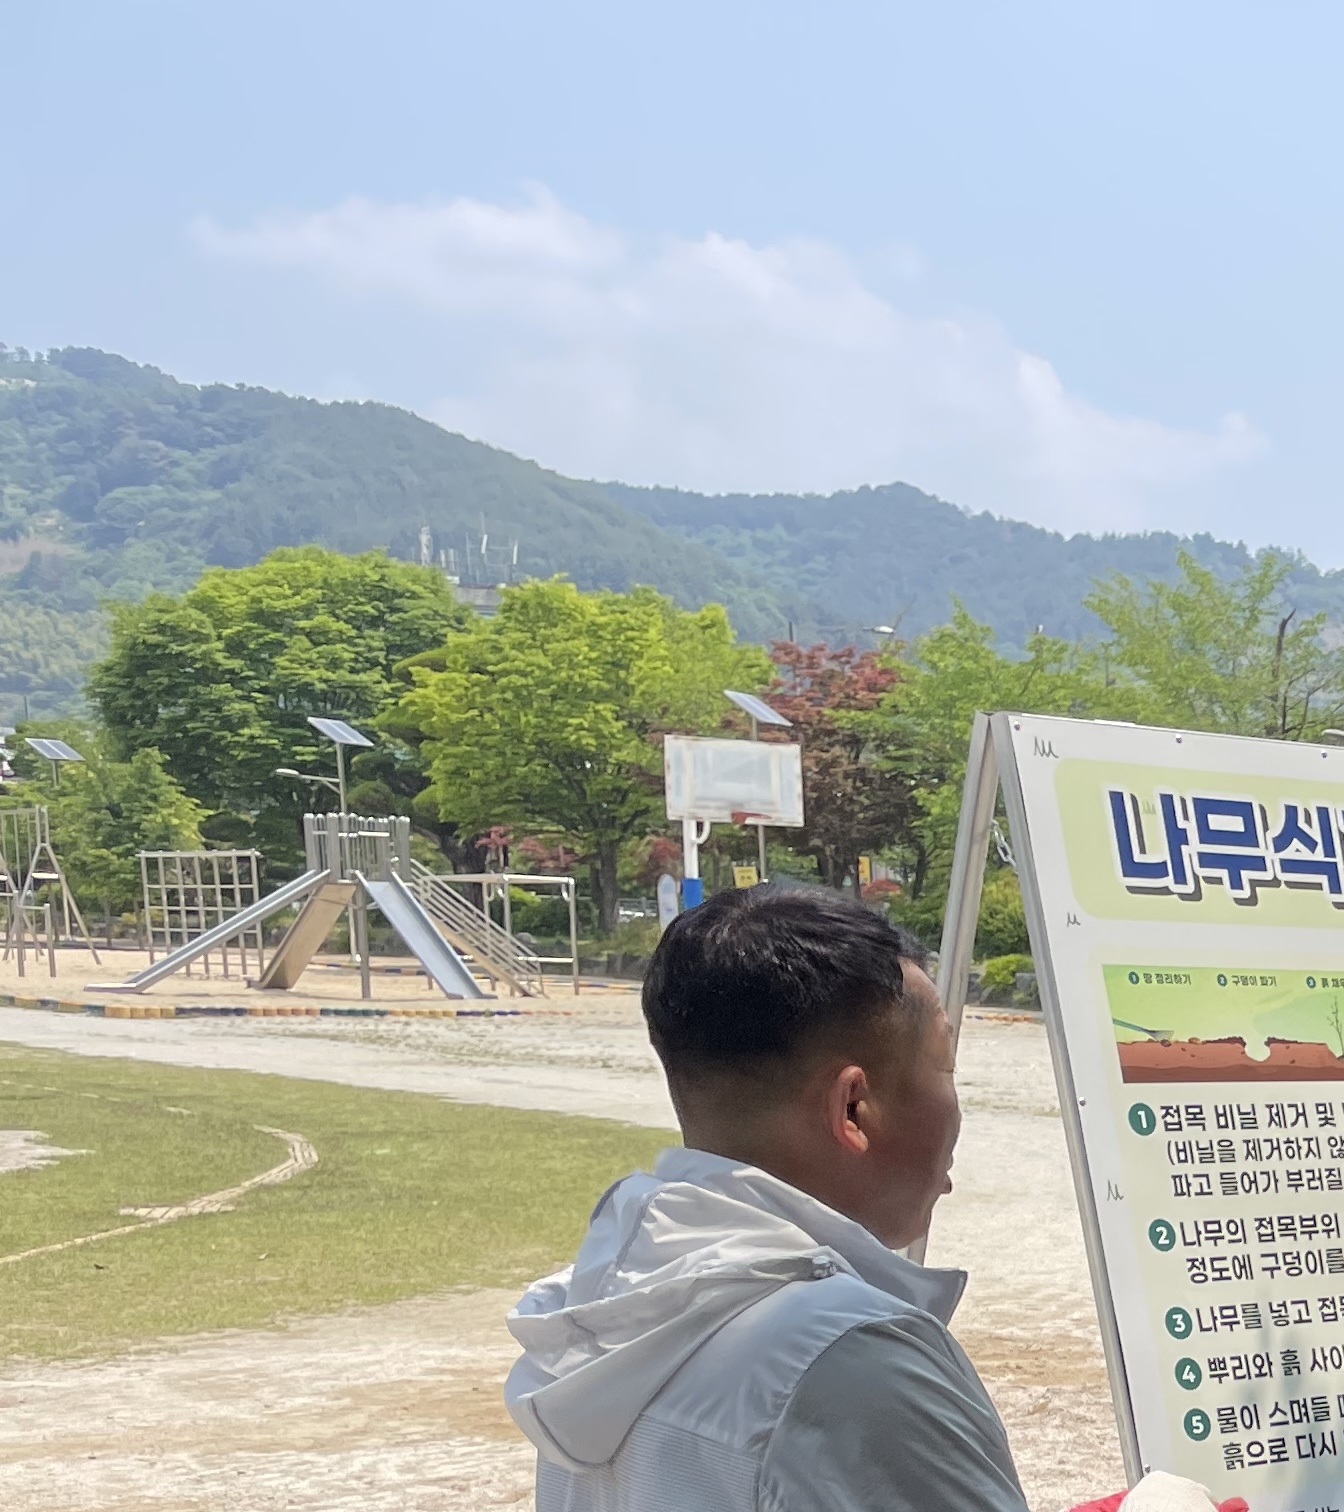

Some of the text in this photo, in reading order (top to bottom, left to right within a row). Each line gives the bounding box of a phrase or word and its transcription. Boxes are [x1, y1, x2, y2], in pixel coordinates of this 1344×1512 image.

[1159, 1104, 1206, 1132] 접목
[1214, 1103, 1259, 1131] 비닐
[1264, 1102, 1309, 1129] 제거
[1314, 1102, 1337, 1128] 및
[1166, 1139, 1237, 1166] (비닐을
[1242, 1136, 1322, 1162] 제거하지
[1170, 1172, 1214, 1198] 파고
[1219, 1169, 1280, 1196] 들어가
[1286, 1166, 1344, 1193] 부러질
[1179, 1218, 1247, 1248] 나무의
[1254, 1213, 1341, 1243] 접목부위
[1186, 1253, 1254, 1285] 정도에
[1195, 1302, 1263, 1333] 나무를
[1268, 1300, 1313, 1328] 넣고
[1207, 1352, 1274, 1384] 뿌리와
[1279, 1348, 1302, 1377] 흙
[1216, 1403, 1262, 1435] 물이
[1268, 1395, 1331, 1428] 스며들
[1223, 1436, 1290, 1472] 흙으로
[1295, 1431, 1338, 1460] 다시
